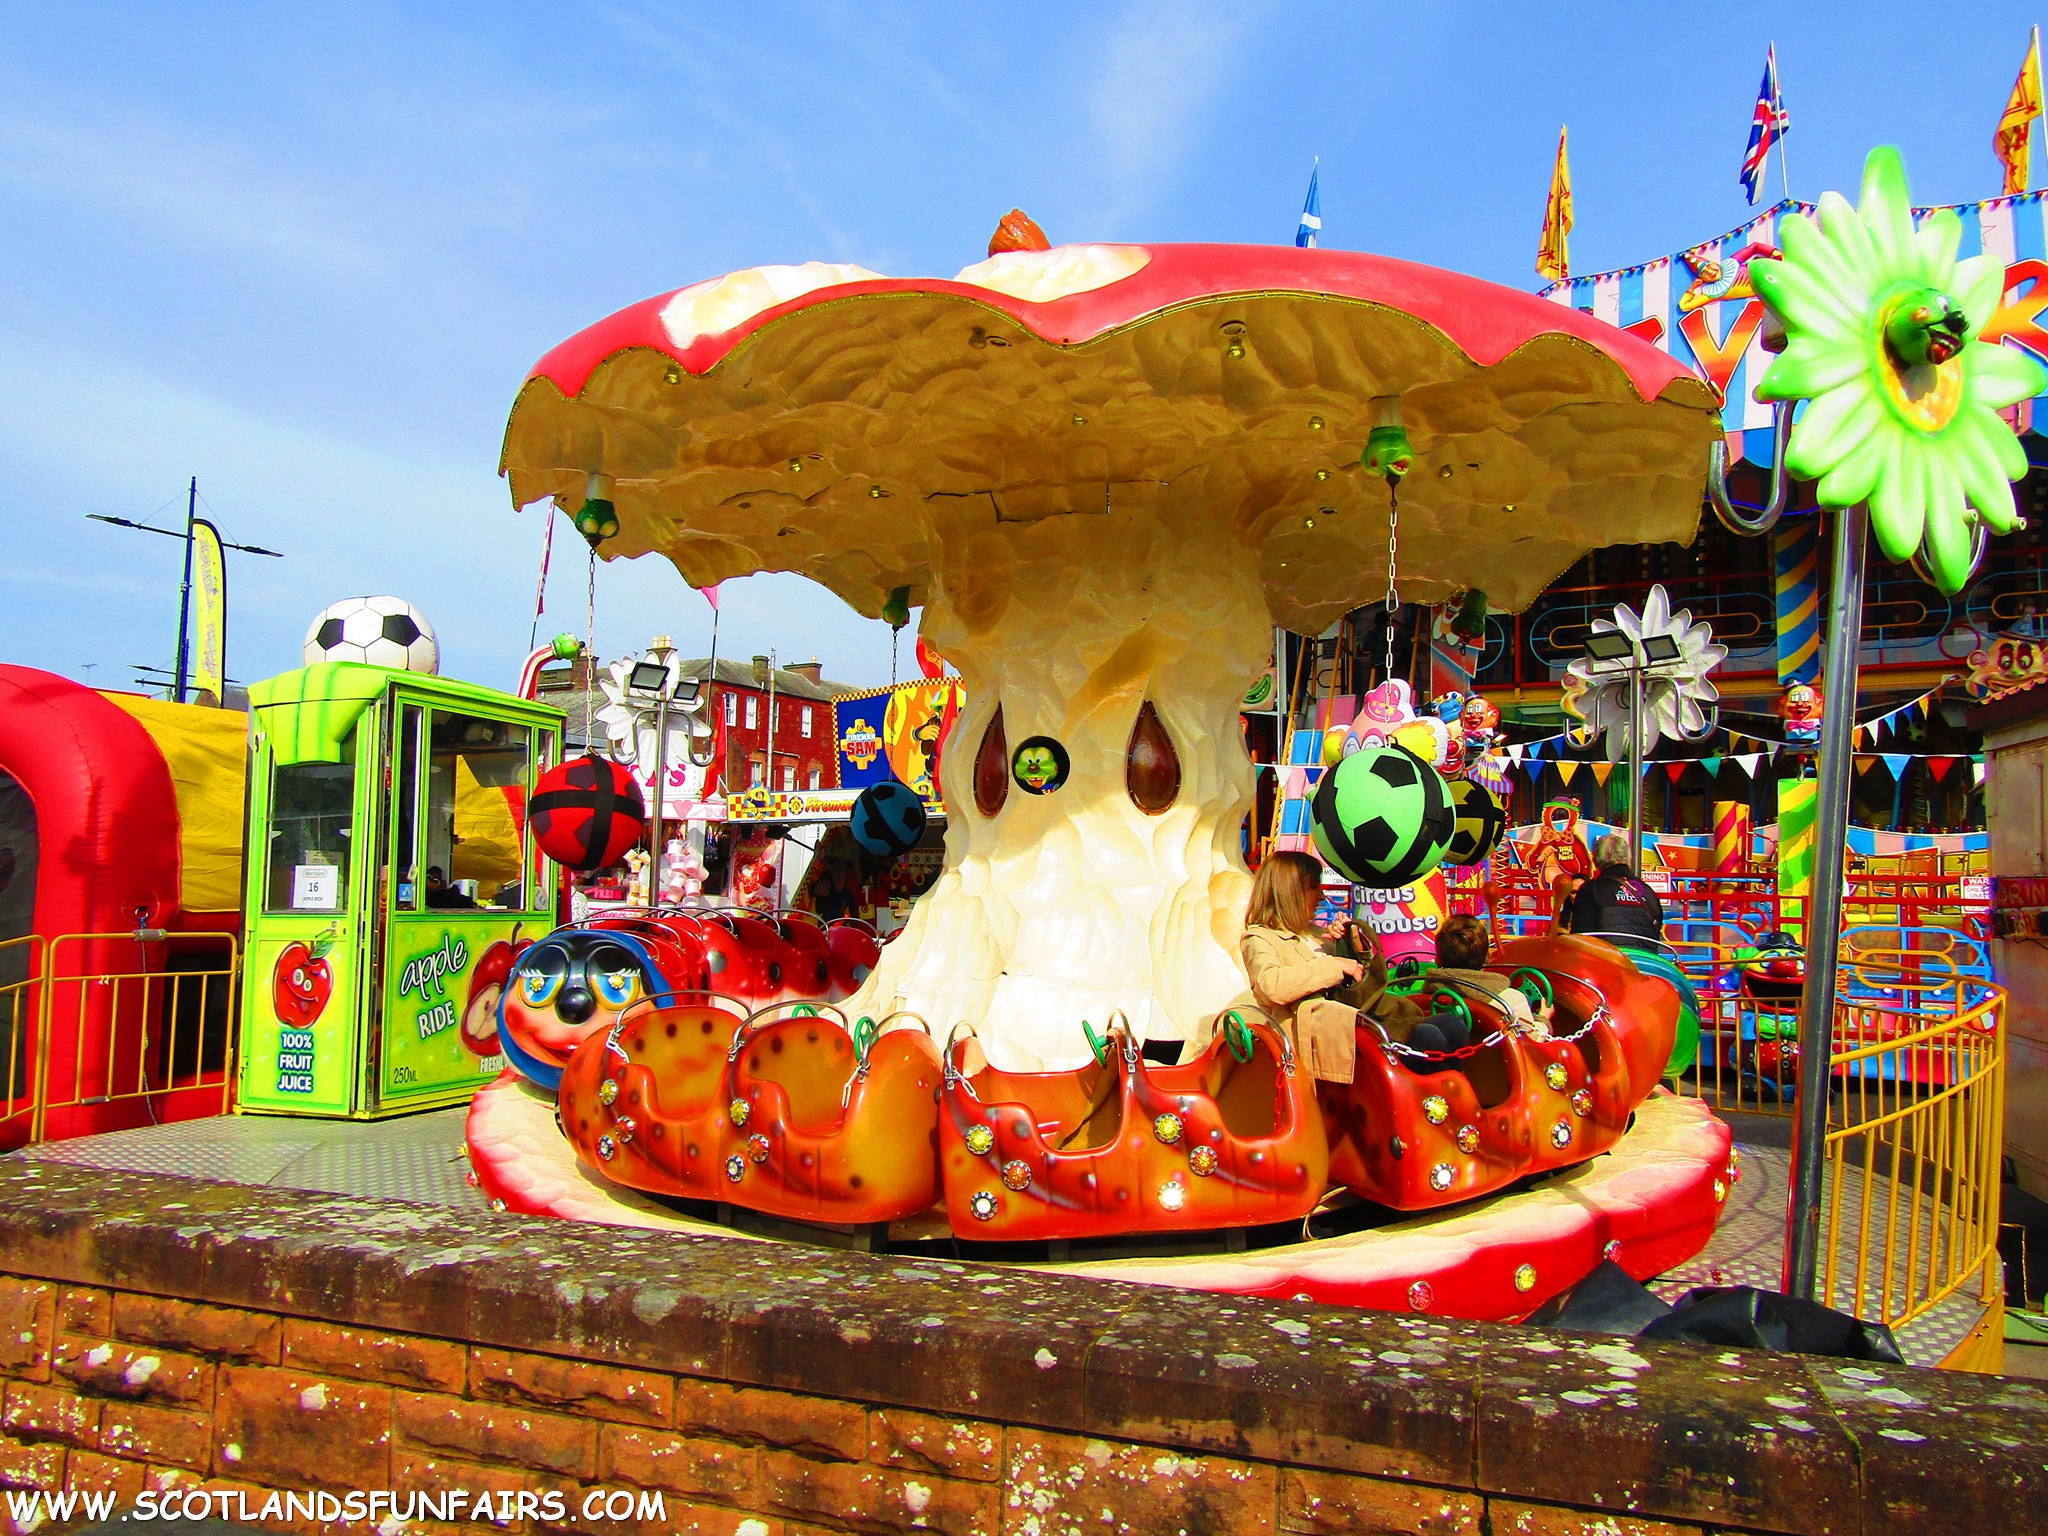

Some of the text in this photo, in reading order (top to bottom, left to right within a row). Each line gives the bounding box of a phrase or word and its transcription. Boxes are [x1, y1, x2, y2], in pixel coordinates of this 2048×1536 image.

[846, 732, 876, 742] FIREMAN
[846, 741, 877, 756] SAM
[1641, 873, 1666, 881] RNING
[308, 881, 319, 893] 16
[1367, 914, 1437, 934] house
[401, 934, 467, 1000] apple
[418, 1001, 455, 1039] RIDE
[281, 1033, 313, 1049] 100%
[279, 1054, 313, 1070] FRUIT
[278, 1075, 312, 1091] JUICE
[394, 1067, 418, 1085] 250ML
